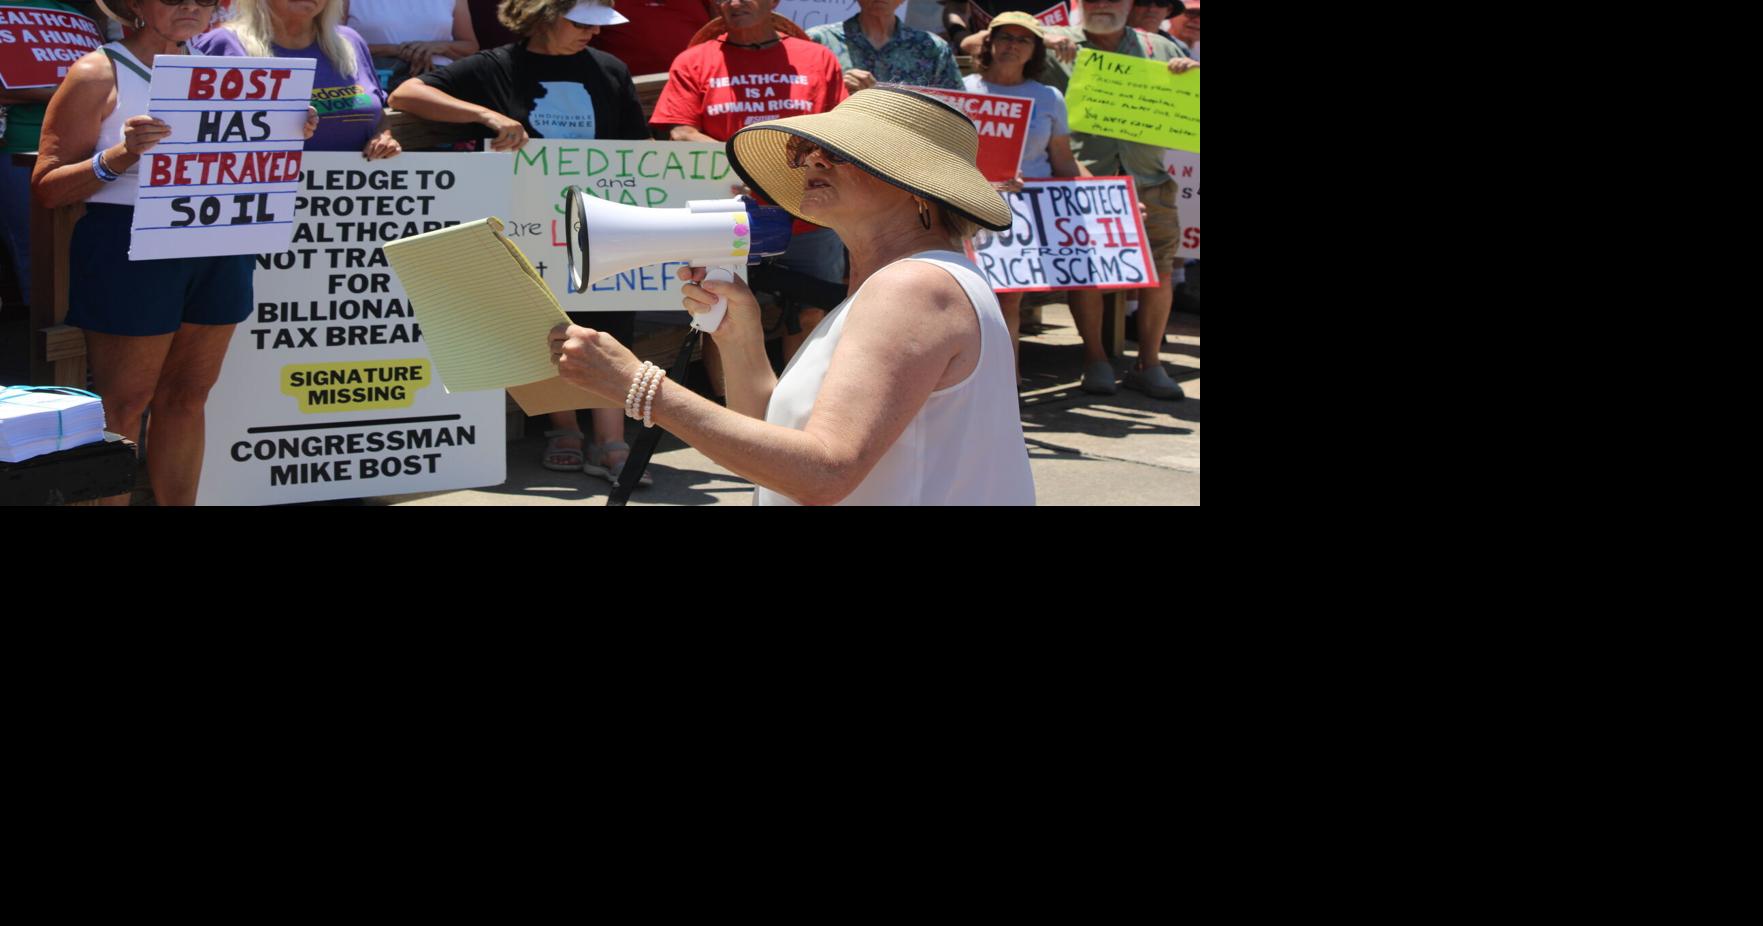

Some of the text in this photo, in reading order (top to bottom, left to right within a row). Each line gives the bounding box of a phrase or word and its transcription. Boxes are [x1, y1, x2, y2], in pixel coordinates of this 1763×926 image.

[22, 29, 38, 43] A
[40, 30, 103, 49] HUMAN
[188, 67, 291, 100] BOST
[709, 73, 808, 88] HEALTHCARE
[745, 87, 775, 98] IS A
[707, 99, 813, 116] HUMAN RIGHT
[197, 111, 271, 142] HAS
[150, 151, 302, 186] BETRAYED
[513, 146, 731, 180] MEDICAID
[416, 170, 456, 190] TO
[596, 177, 636, 188] and
[170, 193, 274, 227] SO IL
[293, 195, 435, 217] PROTECT
[1049, 185, 1128, 216] PROTECT
[509, 220, 543, 238] are
[1097, 217, 1139, 247] IL
[255, 249, 318, 270] NOT
[1021, 247, 1096, 256] FROM
[978, 249, 1144, 287] RICH SCAMS
[328, 274, 390, 294] FOR
[251, 327, 318, 350] TAX
[289, 366, 423, 387] SIGNATURE
[308, 385, 405, 406] MISSING
[230, 425, 476, 462] CONGRESSMAN
[270, 453, 442, 487] MIKE BOST
